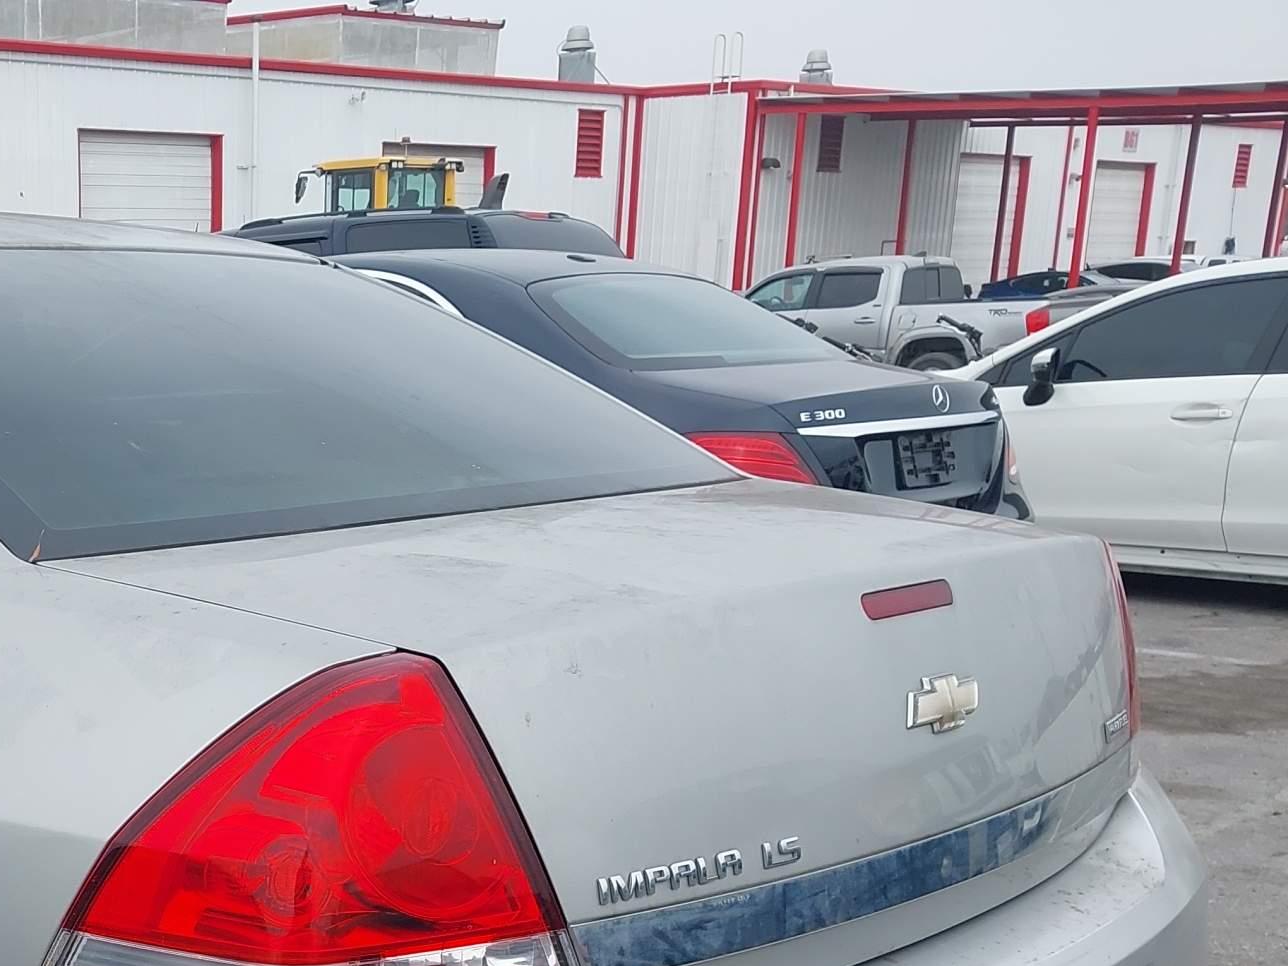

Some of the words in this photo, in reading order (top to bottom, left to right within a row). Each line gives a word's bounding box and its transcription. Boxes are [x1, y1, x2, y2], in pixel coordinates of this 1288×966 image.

[989, 308, 1008, 317] TRD
[800, 412, 812, 422] E
[814, 408, 846, 421] 300
[597, 849, 743, 905] IMPALA
[761, 836, 802, 870] LS
